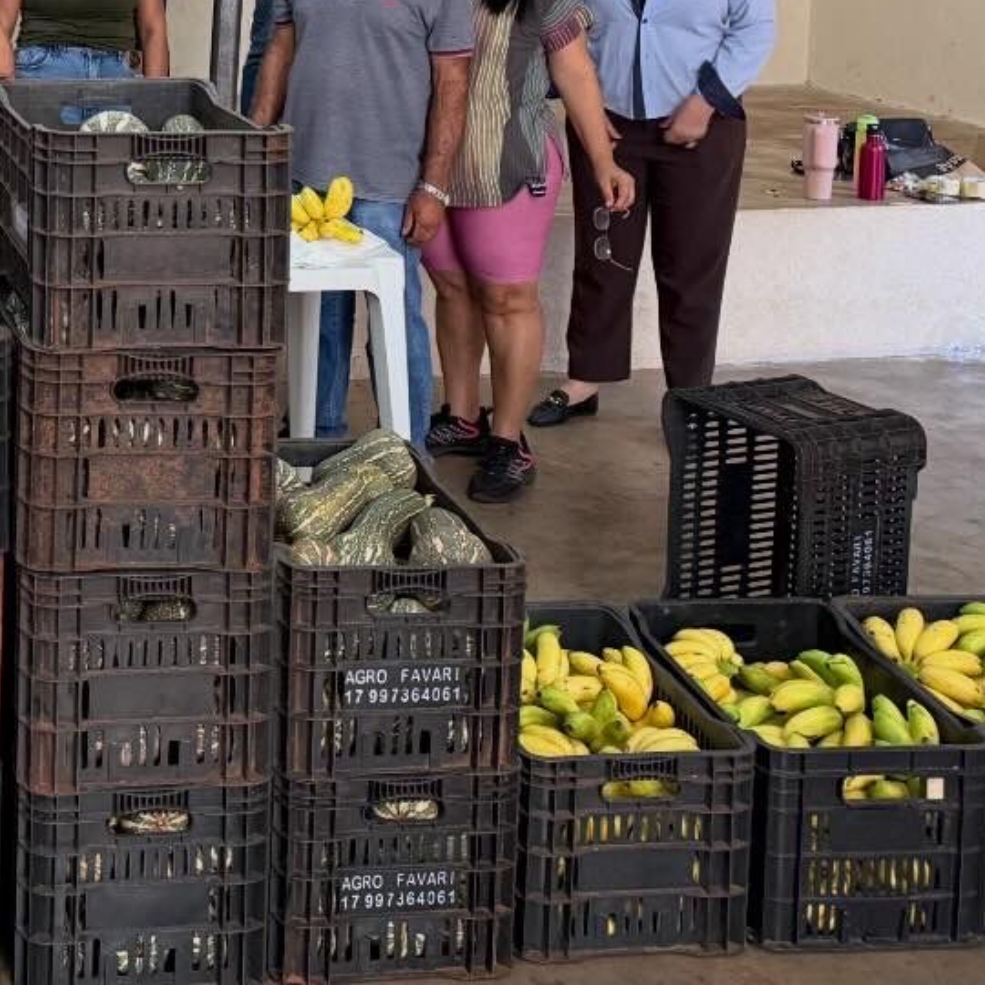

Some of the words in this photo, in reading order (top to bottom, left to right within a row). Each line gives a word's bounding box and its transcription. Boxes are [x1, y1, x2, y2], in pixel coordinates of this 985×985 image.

[345, 668, 388, 685] AGRO
[400, 666, 460, 683] FAVARI
[342, 875, 384, 891] AGRO
[396, 871, 456, 887] FAVARI
